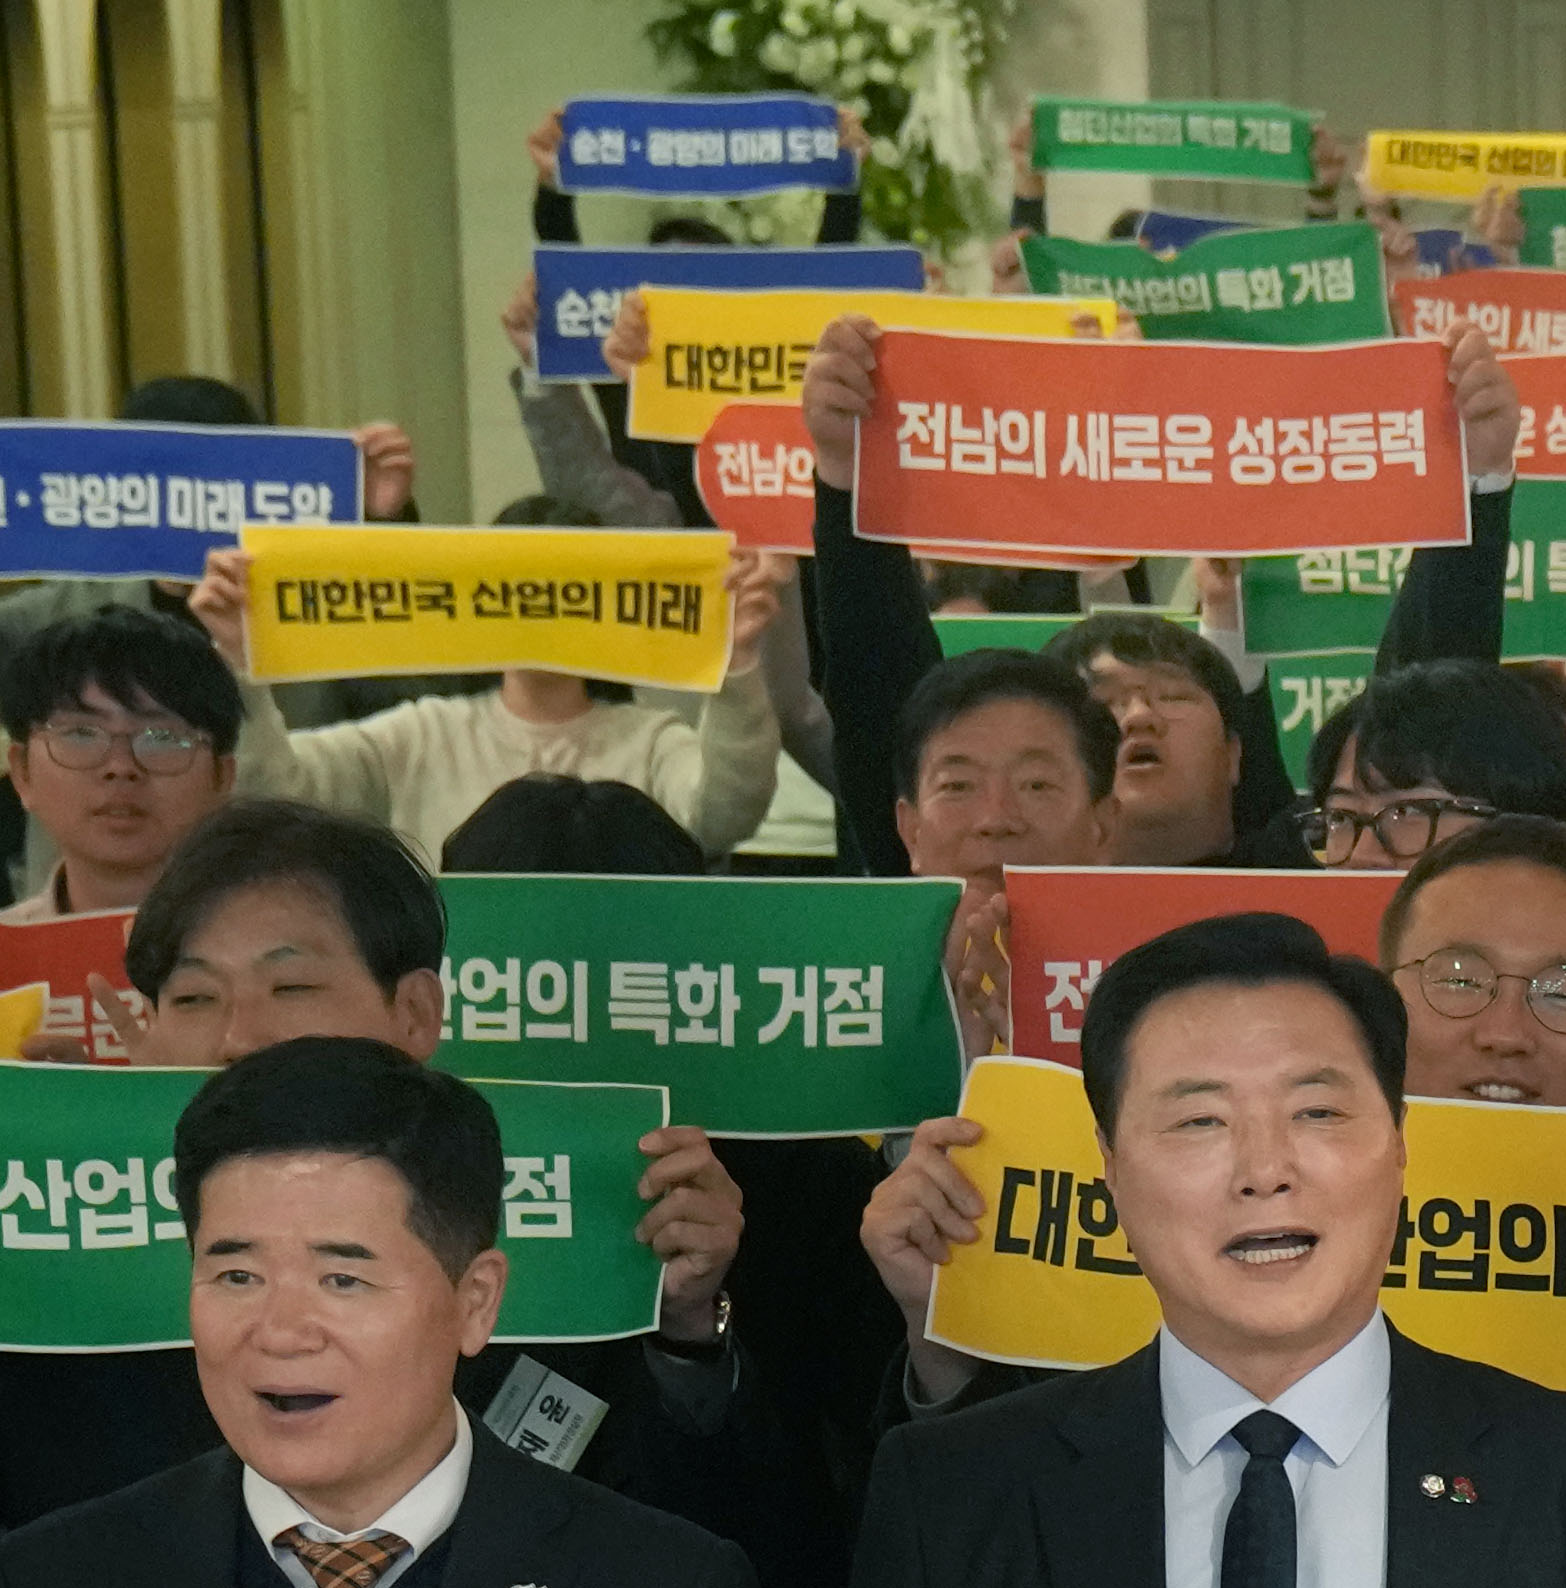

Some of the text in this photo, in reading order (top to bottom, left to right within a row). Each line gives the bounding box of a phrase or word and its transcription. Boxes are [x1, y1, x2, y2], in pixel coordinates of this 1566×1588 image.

[1288, 257, 1355, 304] 거점
[897, 402, 1426, 483] 전남의 새로운 성장동력
[42, 475, 333, 530] 광양의 미래 도약
[276, 580, 701, 633] 대한민국 산업의 미래
[609, 962, 883, 1047] 특화 거점
